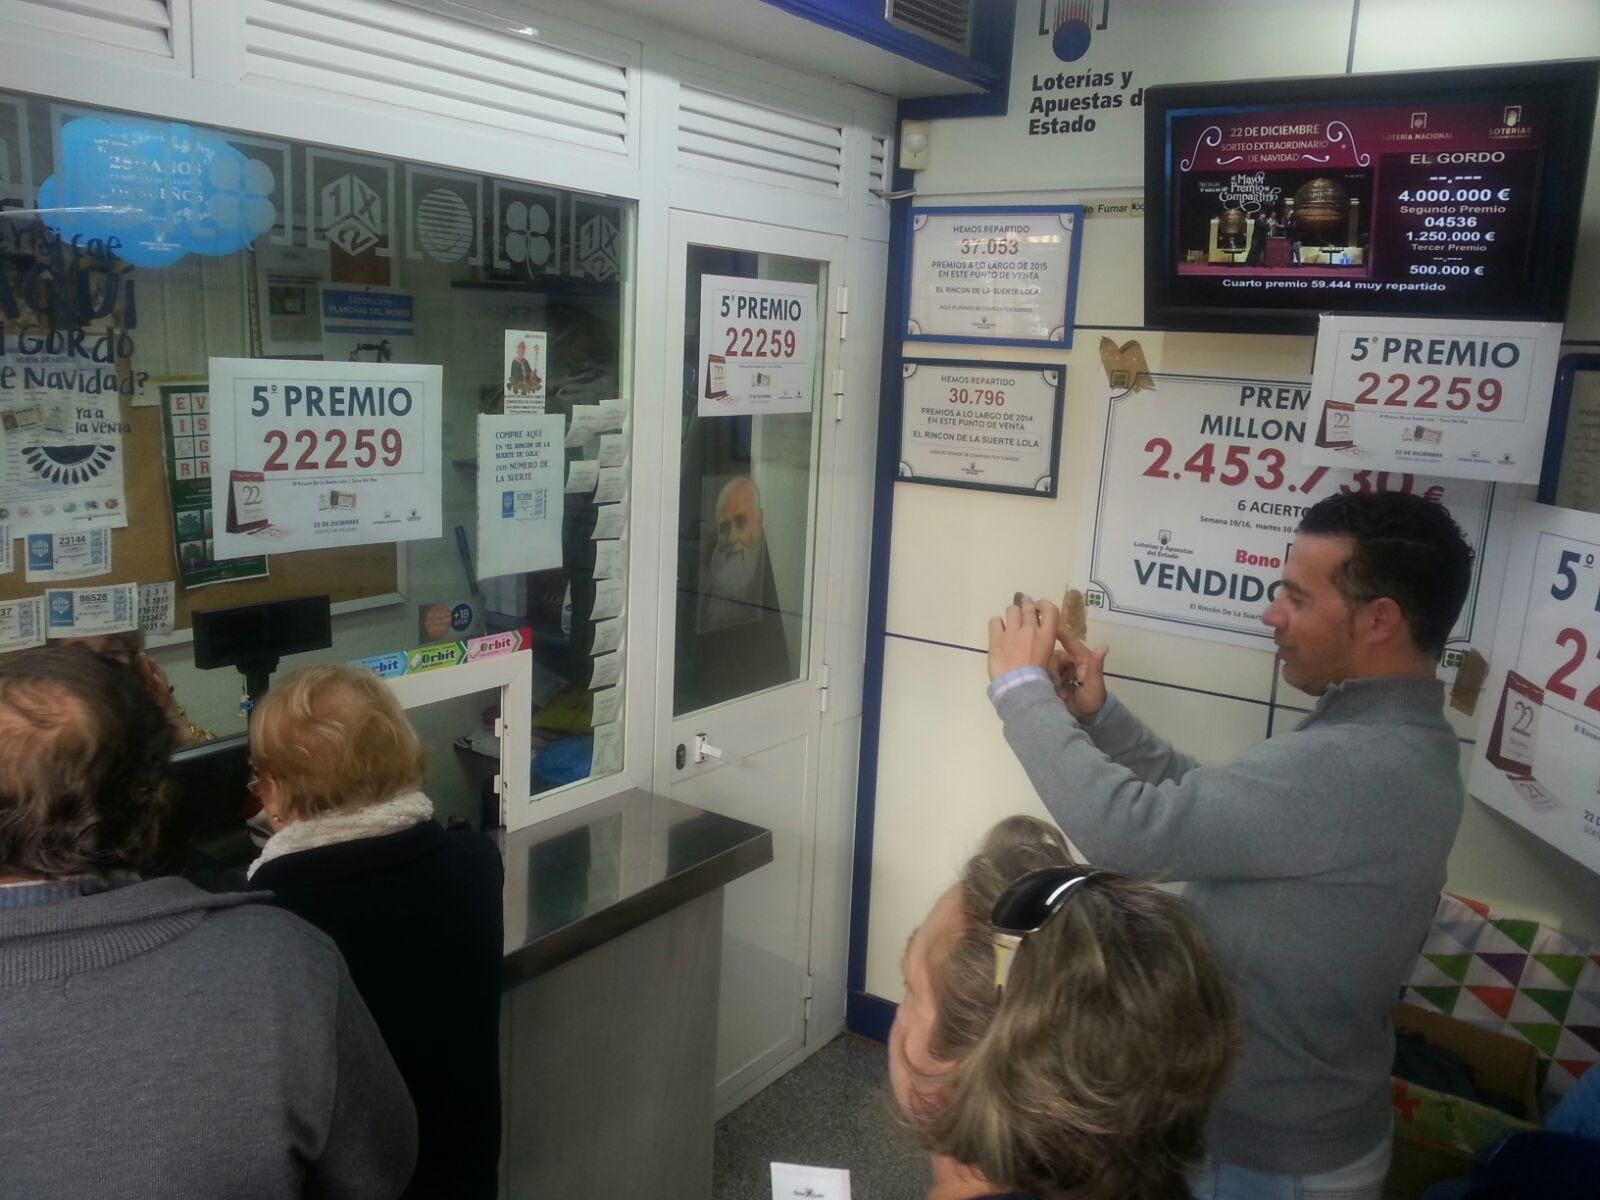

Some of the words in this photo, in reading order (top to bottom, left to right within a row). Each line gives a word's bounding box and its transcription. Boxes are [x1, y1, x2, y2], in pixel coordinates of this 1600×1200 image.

[1032, 68, 1114, 92] Loterías
[1120, 70, 1133, 89] y
[1029, 92, 1123, 117] Apuestas
[1130, 88, 1145, 107] d
[1028, 114, 1096, 135] Estado
[1231, 127, 1243, 137] 22
[1245, 127, 1259, 137] DE
[1260, 124, 1320, 136] DICIEMBRE
[1221, 141, 1253, 152] SORTEO
[1254, 140, 1328, 151] EXTRAORDINARIO
[1248, 154, 1259, 163] DE
[1260, 153, 1299, 163] NAVIDAD
[1410, 153, 1431, 164] EL
[1437, 151, 1506, 163] GORDO
[1398, 189, 1491, 202] 4.000.000
[1497, 188, 1511, 201] €
[1098, 204, 1129, 213] Fumar
[1400, 205, 1456, 215] Segundo
[1460, 204, 1506, 214] Premio
[1425, 217, 1477, 228] 04536
[953, 225, 981, 233] HEMOS
[983, 225, 1031, 234] REPARTIDO
[1406, 231, 1481, 241] 1.250.000
[1485, 231, 1496, 241] €
[960, 239, 1019, 255] 37.053
[1411, 243, 1445, 252] Tercer
[1448, 243, 1487, 252] Premio
[932, 260, 967, 269] PREMIOS
[987, 262, 1016, 270] LARGO
[1018, 262, 1028, 270] DE
[1030, 262, 1048, 271] 2015
[1409, 265, 1470, 275] 500.000
[1474, 265, 1485, 275] €
[970, 271, 998, 279] PUNTO
[1000, 271, 1011, 279] DE
[1222, 278, 1262, 288] Cuarto
[1265, 279, 1308, 290] premio
[1311, 280, 1352, 289] 59.444
[1354, 283, 1382, 292] muy
[1386, 281, 1447, 292] repartido
[737, 295, 802, 322] PREMIO
[724, 326, 796, 359] 22259
[1382, 336, 1521, 369] PREMIO
[941, 376, 969, 385] HEMOS
[971, 376, 1016, 386] REPARTIDO
[949, 387, 1005, 407] 30.796
[1354, 371, 1503, 413] 22259
[284, 385, 413, 417] PREMIO
[921, 407, 955, 417] PREMIOS
[955, 409, 961, 417] A
[963, 410, 974, 418] LO
[974, 411, 1002, 421] LARGO
[1003, 413, 1014, 421] DE
[1016, 413, 1033, 422] 2014
[928, 416, 938, 424] EN
[939, 417, 956, 426] ESTE
[958, 419, 985, 428] PUNTO
[987, 421, 997, 429] DE
[999, 421, 1025, 431] VENTA
[496, 430, 523, 439] COMPRE
[913, 430, 923, 438] EL
[956, 433, 967, 441] DE
[969, 434, 980, 443] LA
[982, 435, 1015, 446] SUERTE
[1016, 438, 1040, 448] LOLA
[263, 427, 403, 472] 22259
[1238, 500, 1246, 511] 6
[1200, 516, 1228, 526] Semana
[1255, 523, 1281, 533] martes
[1283, 526, 1292, 534] 10
[59, 535, 86, 545] 23144
[1235, 549, 1281, 569] Bono
[453, 608, 470, 620] +18
[1190, 603, 1196, 611] El
[1222, 608, 1232, 616] De
[1233, 609, 1242, 617] La
[480, 637, 511, 652] Orbit
[422, 651, 455, 663] Orbit
[371, 660, 399, 673] rbit
